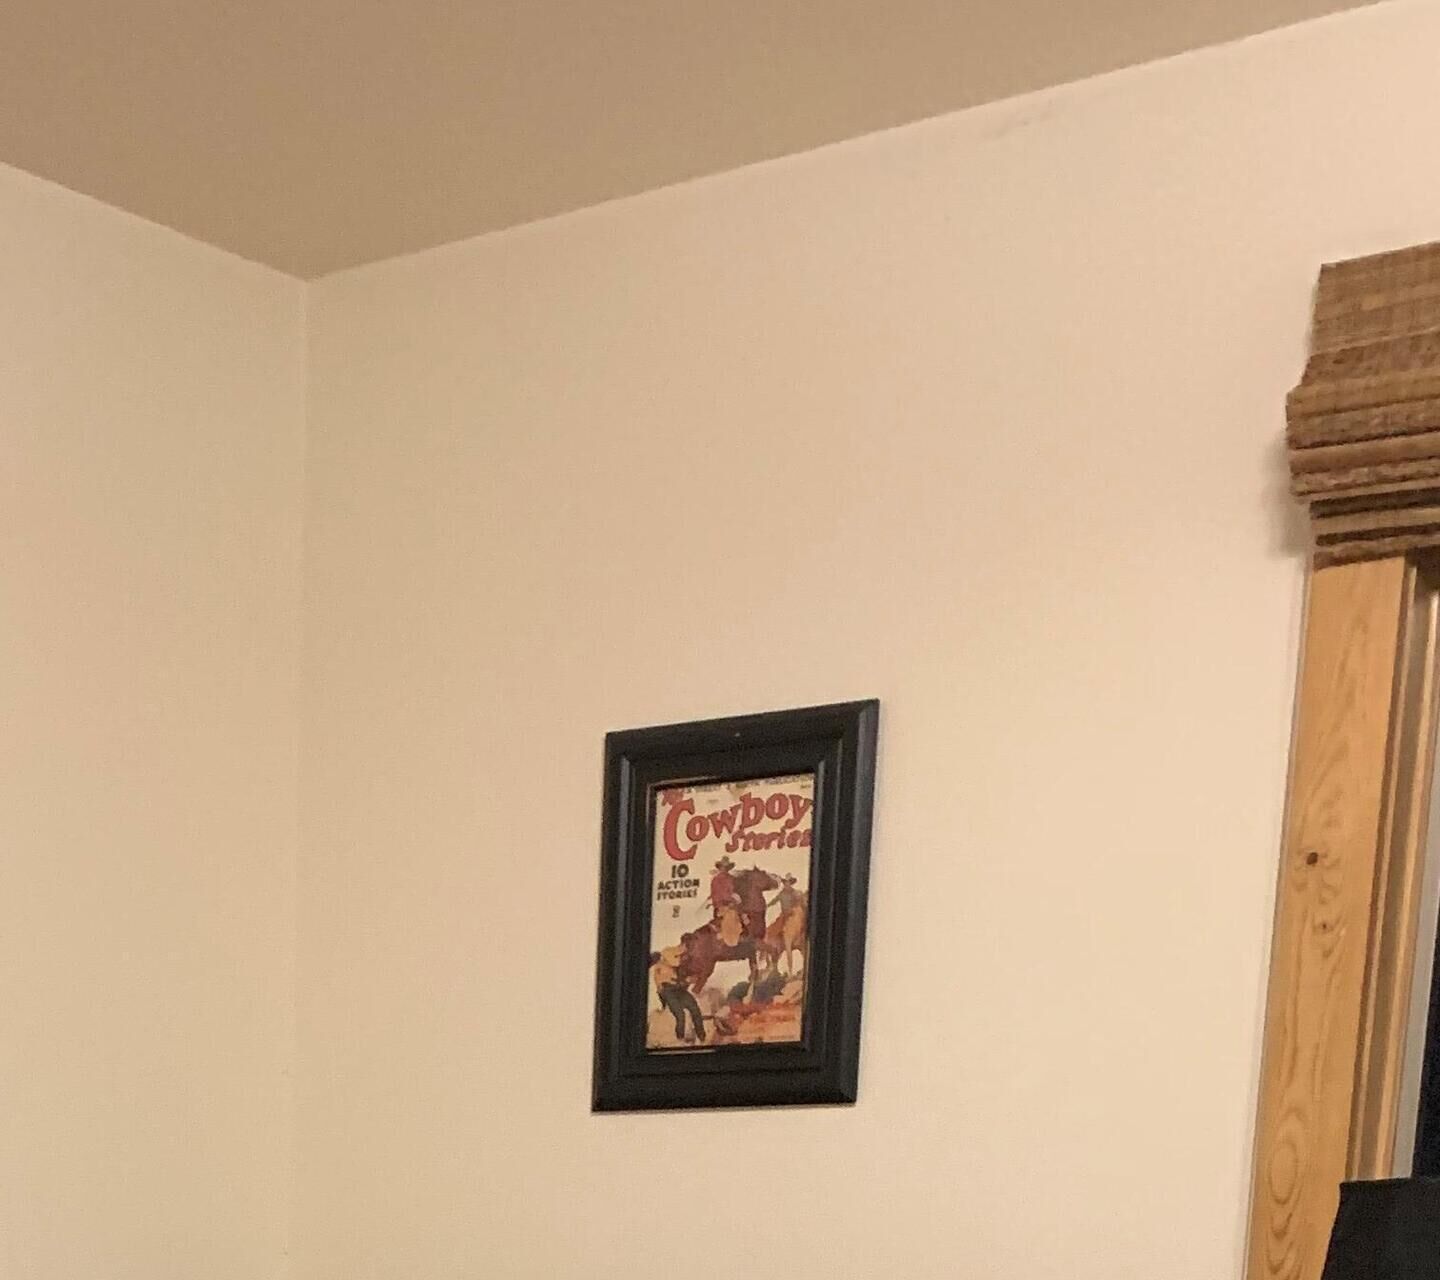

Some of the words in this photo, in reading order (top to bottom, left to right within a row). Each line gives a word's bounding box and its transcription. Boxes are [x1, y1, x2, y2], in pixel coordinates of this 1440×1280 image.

[663, 792, 812, 861] Cowboy
[725, 826, 811, 853] Stories
[671, 863, 689, 879] 10
[657, 878, 700, 890] ACTION
[656, 888, 698, 901] STORIES
